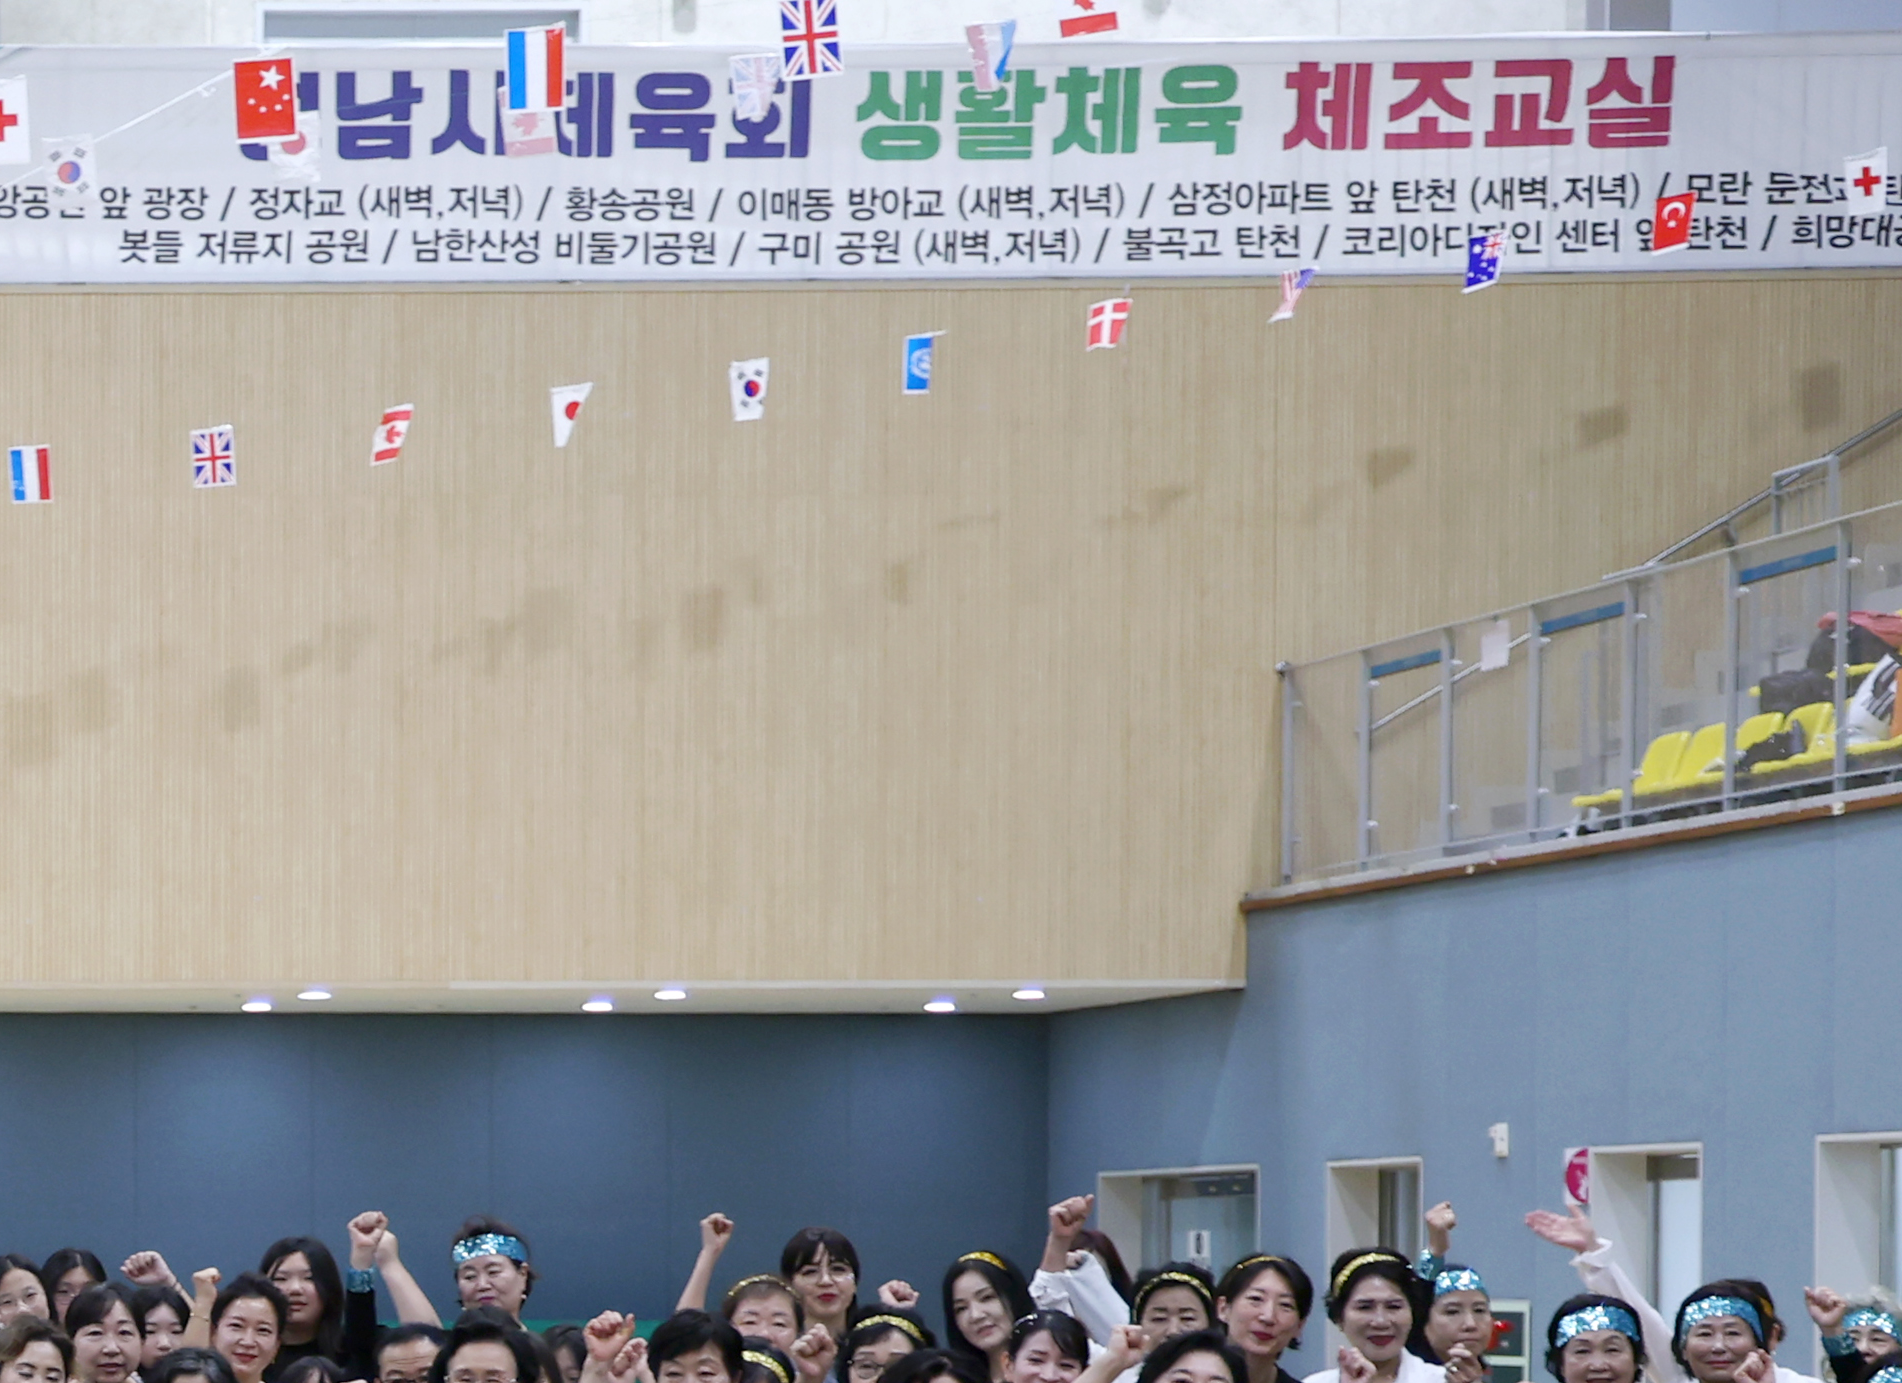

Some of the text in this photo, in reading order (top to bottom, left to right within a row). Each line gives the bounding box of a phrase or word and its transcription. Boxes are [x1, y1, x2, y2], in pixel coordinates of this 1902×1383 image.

[856, 60, 1244, 163] 생활체육
[1283, 54, 1678, 153] 체조교실
[100, 184, 134, 219] 앞
[141, 184, 210, 221] 광장
[249, 185, 345, 220] 정자교
[357, 182, 526, 222] (새벽,저녁)
[564, 186, 696, 222] 황송공원
[738, 186, 836, 221] 이매동
[849, 185, 946, 220] 방아교
[958, 183, 1126, 220] (새벽,저녁)
[1168, 180, 1334, 217] 삼정아파트
[1347, 180, 1380, 216] 앞
[1392, 178, 1458, 216] 탄천
[1470, 175, 1642, 213] (새벽,저녁)
[1687, 172, 1754, 206] 모란
[119, 230, 184, 265] 봇들
[197, 231, 295, 266] 저류지
[306, 230, 371, 264] 공원
[412, 230, 541, 266] 남한산성
[555, 230, 718, 266] 비둘기공원
[758, 230, 824, 266] 구미
[837, 229, 902, 266] 공원
[914, 228, 1082, 264] (새벽,저녁)
[1123, 226, 1220, 262] 불곡고
[1236, 224, 1301, 261] 탄천
[1556, 219, 1622, 256] 센터
[1688, 217, 1748, 250] 탄천
[1792, 213, 1902, 249] 희망대
